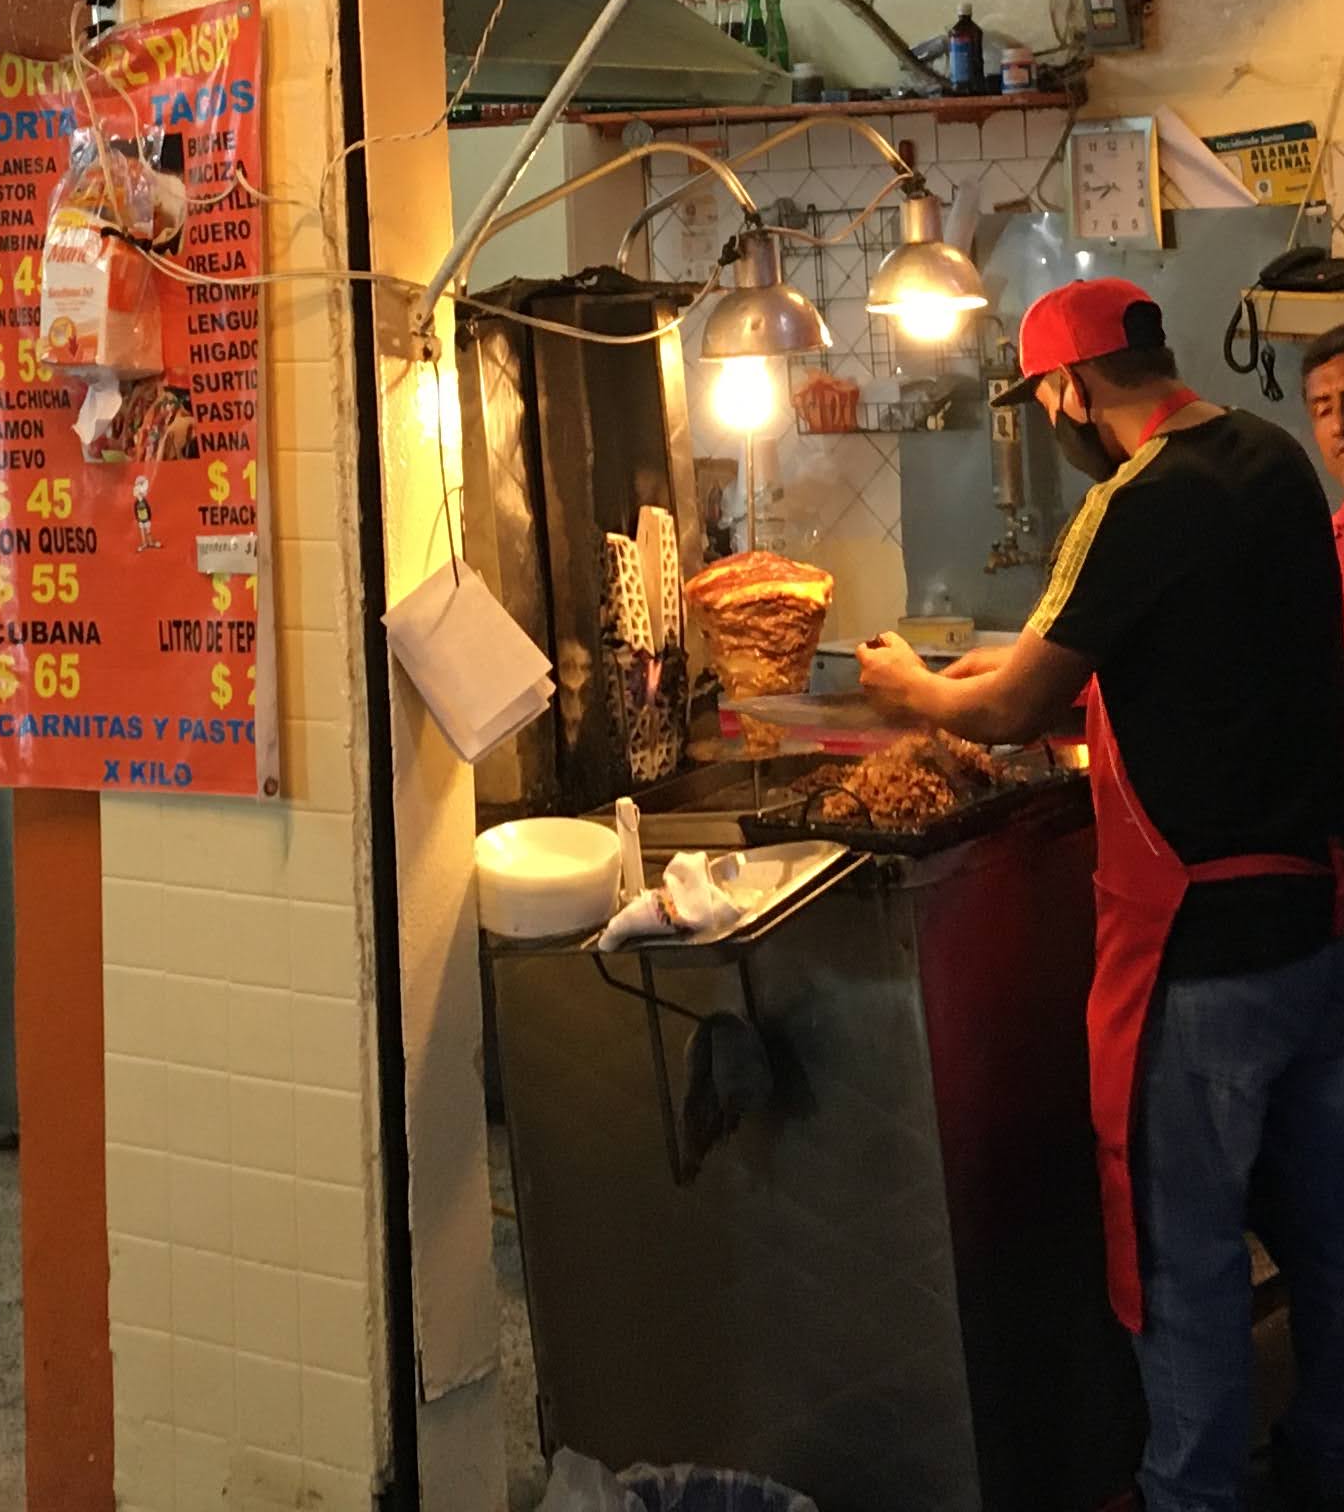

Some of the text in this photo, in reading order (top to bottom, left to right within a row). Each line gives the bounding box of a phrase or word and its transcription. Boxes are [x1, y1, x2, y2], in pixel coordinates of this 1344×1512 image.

[150, 80, 255, 126] TACOS
[1250, 142, 1309, 161] ALARMA
[1251, 155, 1311, 174] VECINAL
[189, 219, 251, 245] CUERO
[14, 255, 43, 296] 4
[186, 249, 246, 274] OREJA
[200, 432, 250, 452] NANA
[26, 478, 72, 519] 45
[38, 526, 97, 555] QUESO
[31, 562, 80, 603] 55
[158, 619, 256, 653] LITRO DE TEP
[34, 652, 80, 699] 65
[153, 716, 169, 740] Y
[103, 759, 193, 786] X KILO
